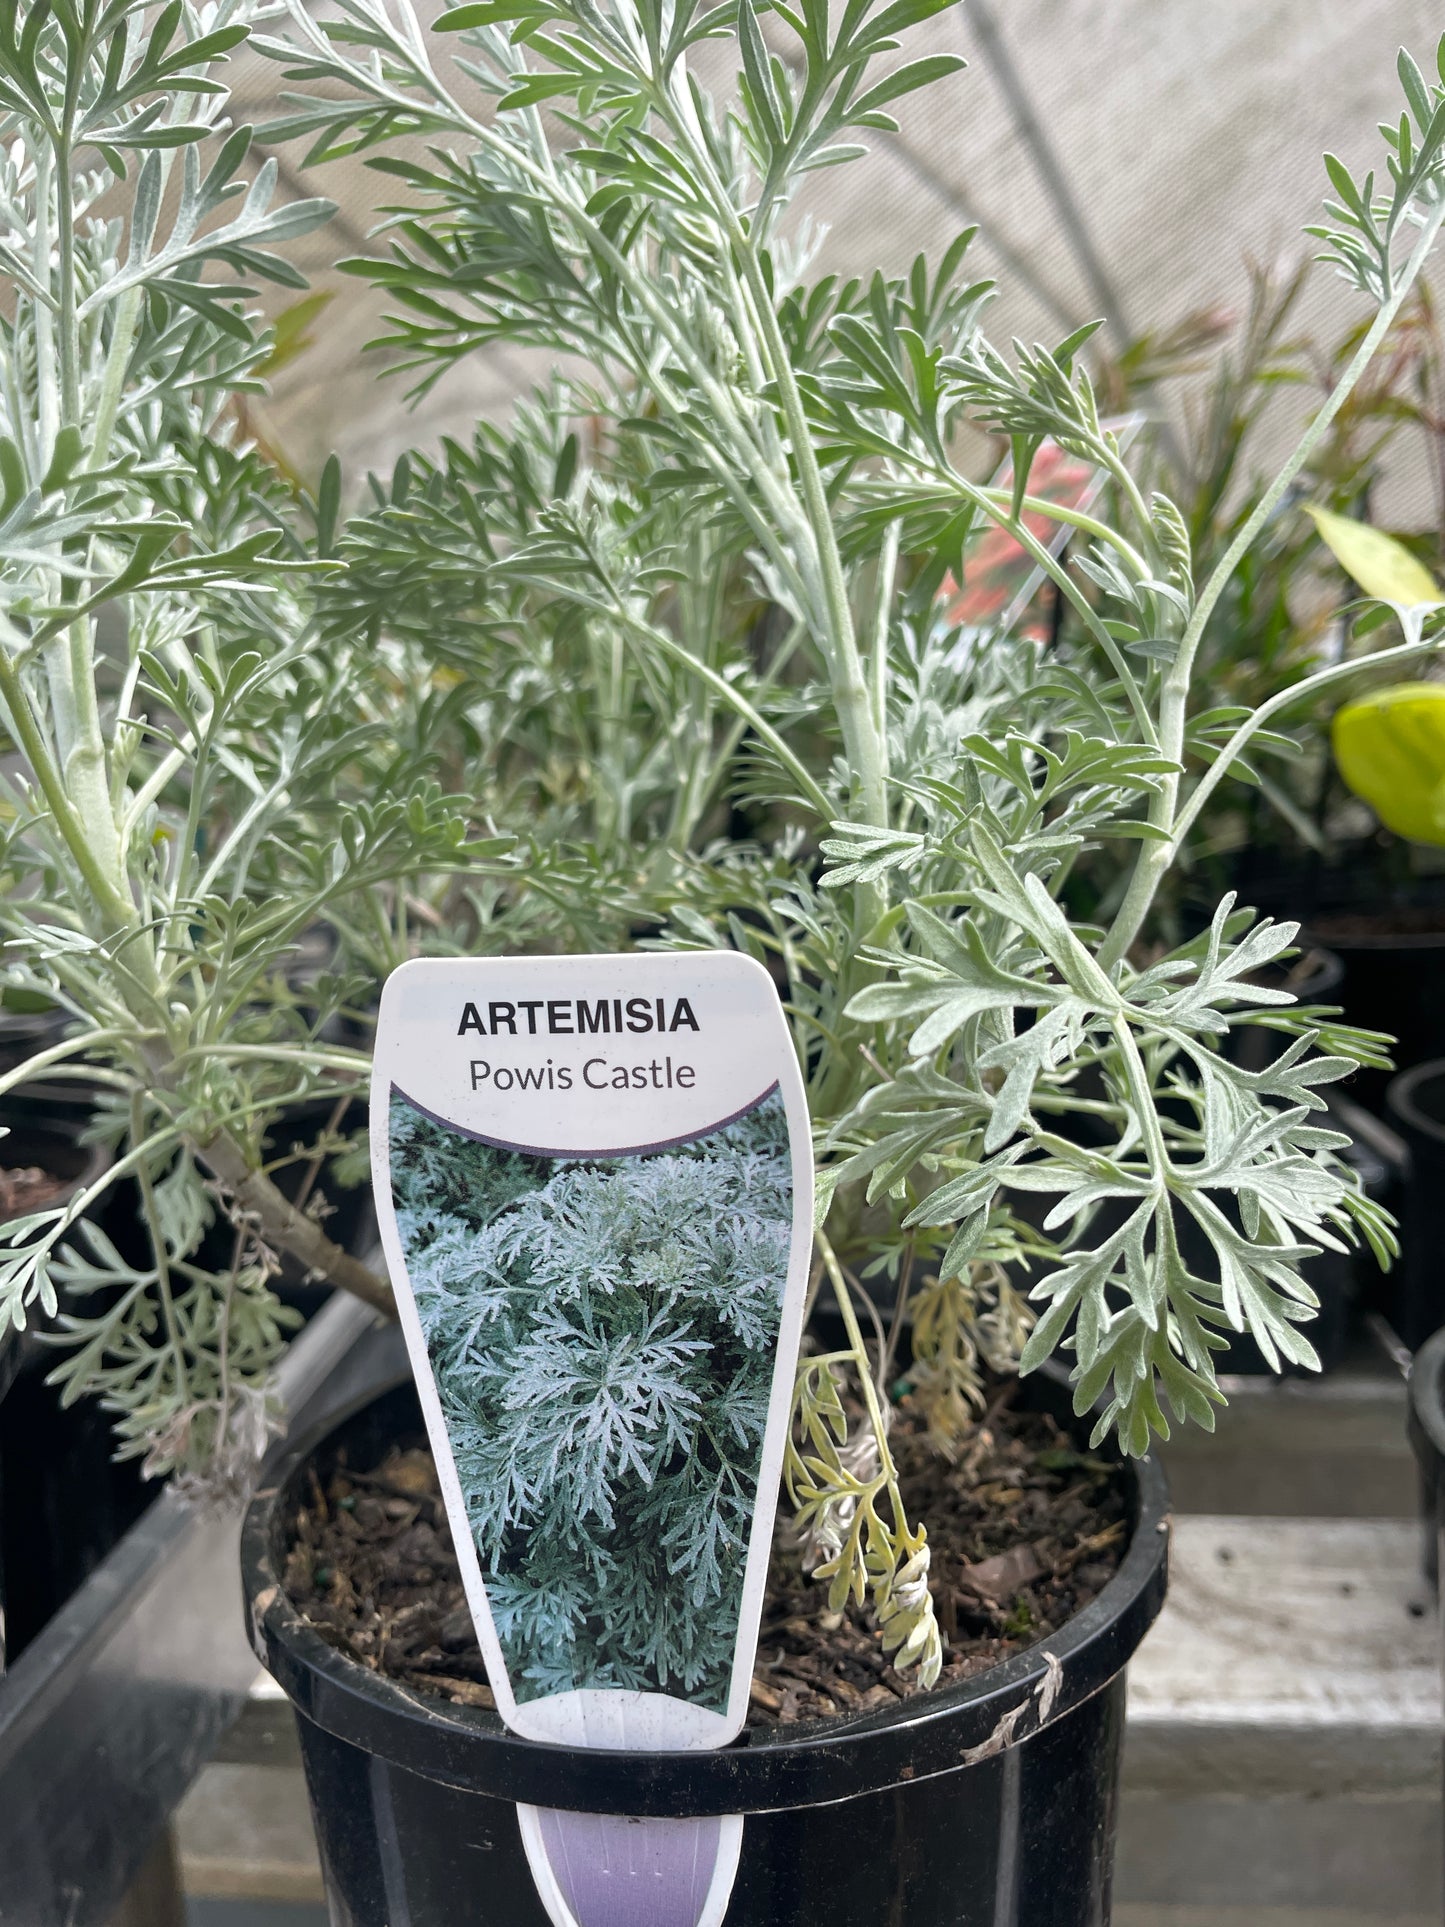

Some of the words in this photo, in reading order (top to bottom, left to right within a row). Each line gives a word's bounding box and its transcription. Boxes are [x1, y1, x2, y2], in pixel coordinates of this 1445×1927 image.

[456, 997, 701, 1036] ARTEMISIA
[470, 1058, 573, 1091] Powis
[582, 1056, 696, 1090] Castle
